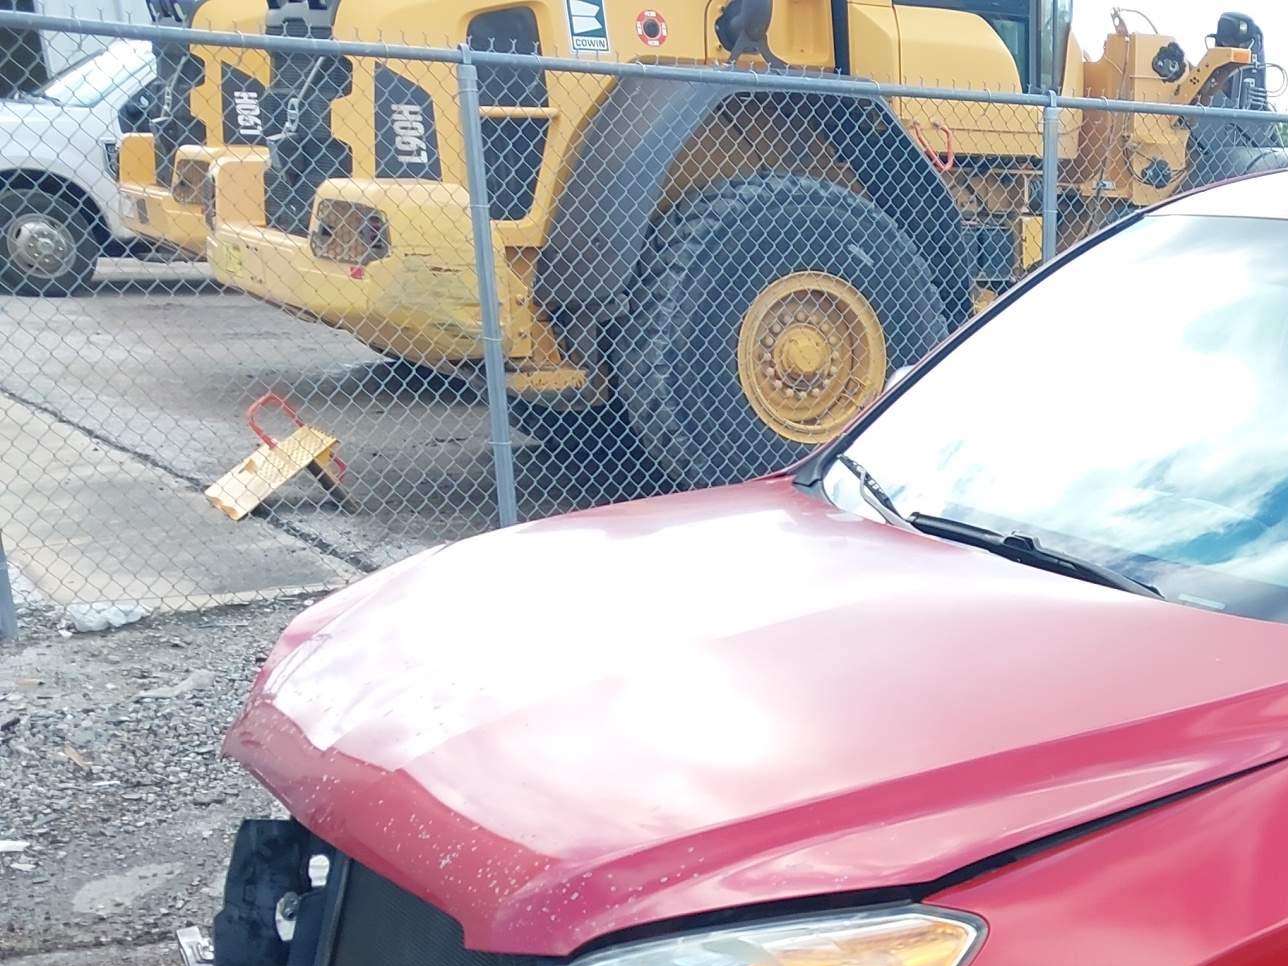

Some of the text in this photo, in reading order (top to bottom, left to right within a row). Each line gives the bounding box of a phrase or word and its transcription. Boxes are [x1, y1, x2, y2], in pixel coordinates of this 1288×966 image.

[575, 38, 606, 48] COWIN
[234, 91, 262, 135] L90H
[391, 104, 428, 163] L90H
